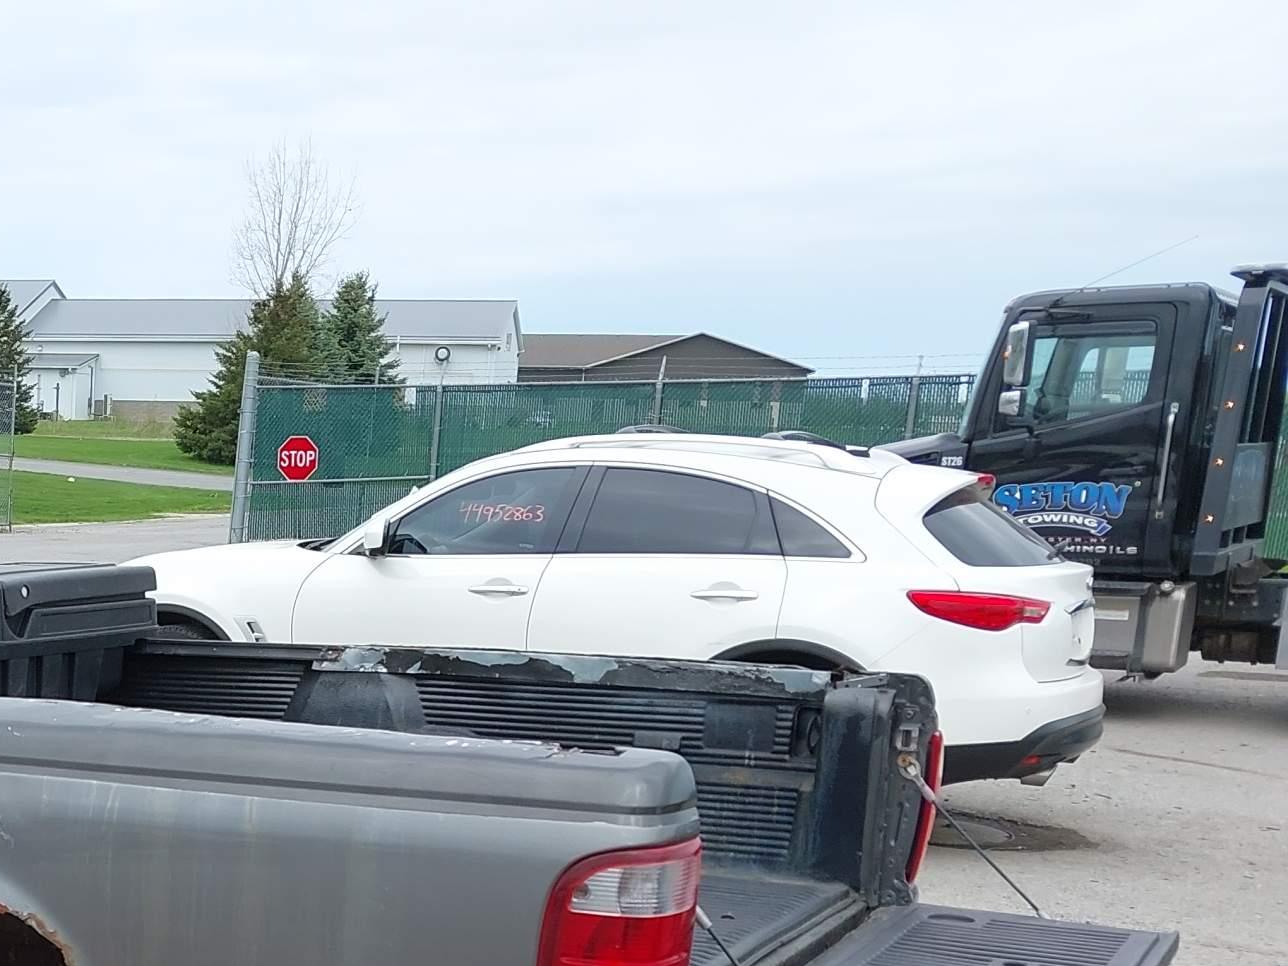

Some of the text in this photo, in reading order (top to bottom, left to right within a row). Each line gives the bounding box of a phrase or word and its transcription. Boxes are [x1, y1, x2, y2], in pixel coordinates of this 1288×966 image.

[280, 450, 315, 468] STOP
[992, 481, 1135, 519] SETON
[458, 501, 545, 522] 44952863
[1018, 513, 1099, 528] TOWING
